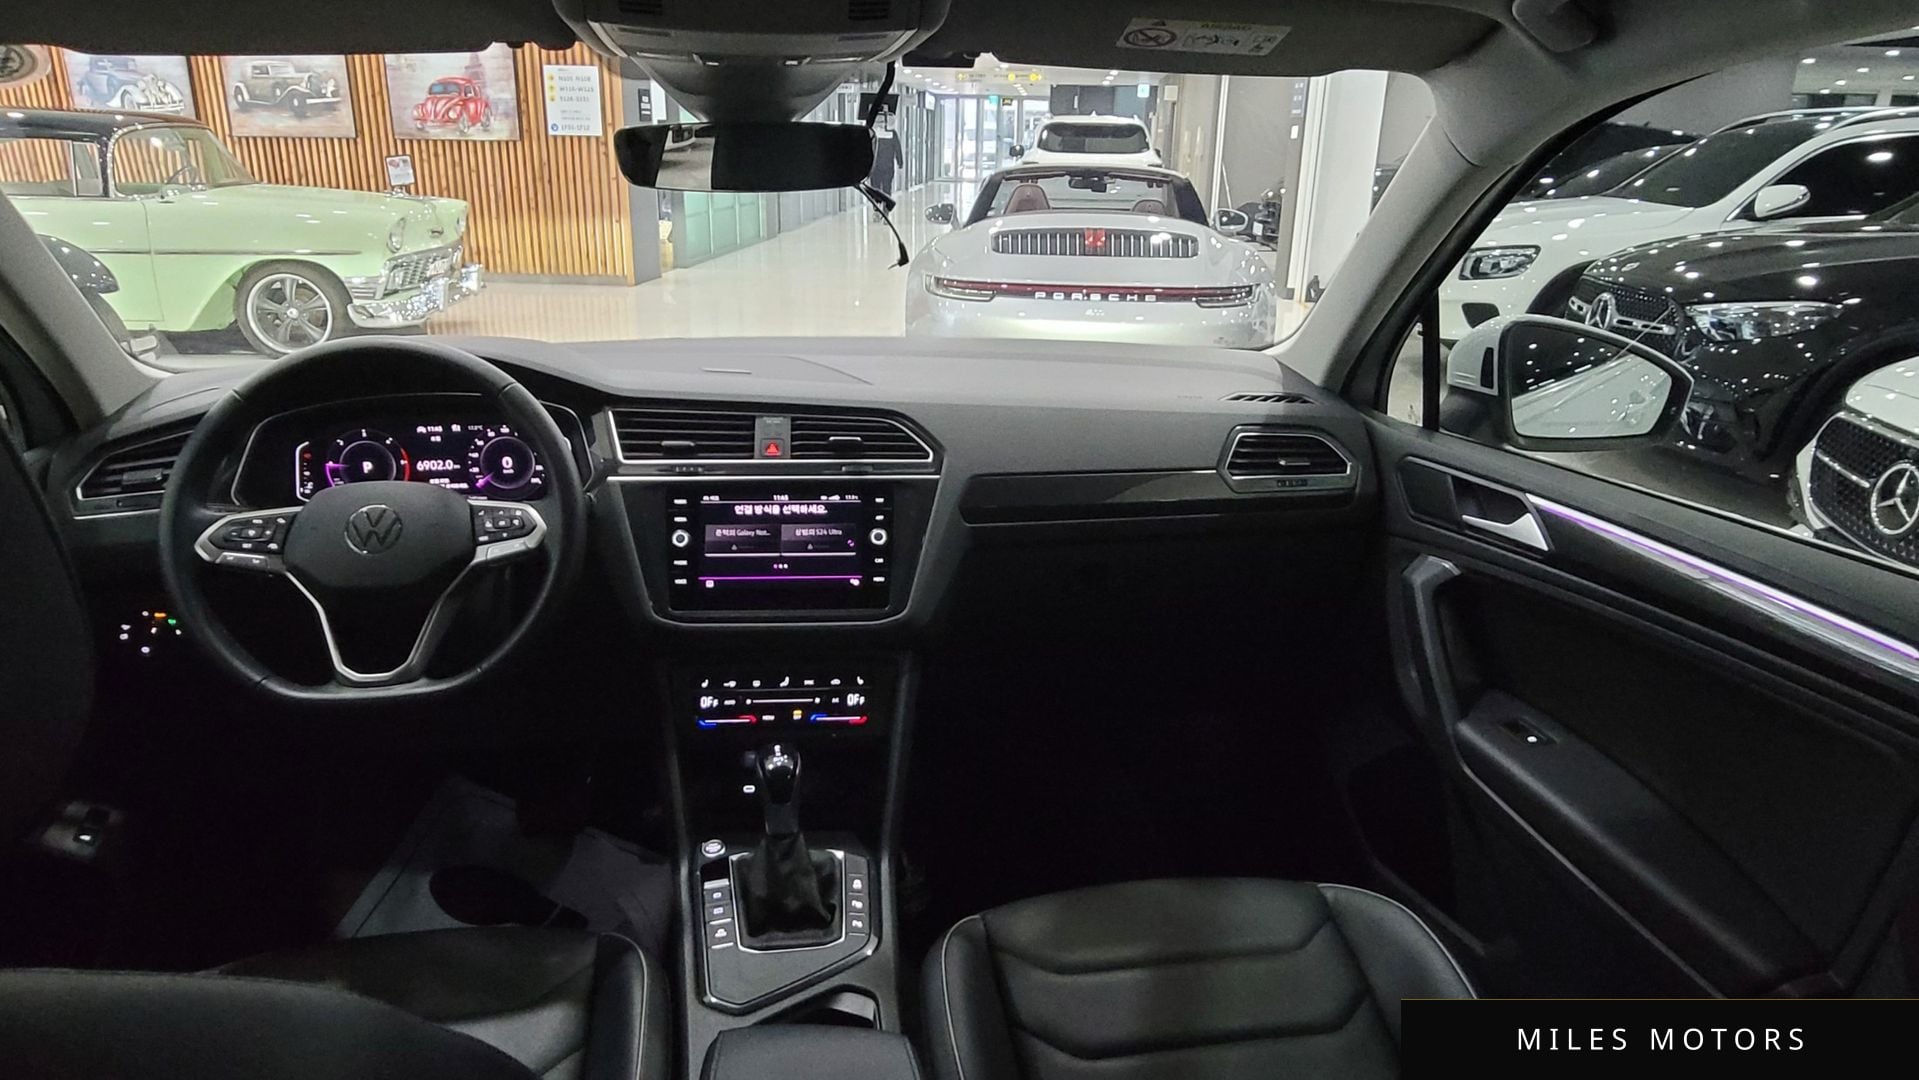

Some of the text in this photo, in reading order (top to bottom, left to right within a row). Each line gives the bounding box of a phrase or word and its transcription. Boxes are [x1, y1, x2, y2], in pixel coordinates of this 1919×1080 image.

[1035, 291, 1157, 302] PORSCHE
[363, 461, 374, 474] P
[502, 456, 513, 468] 0
